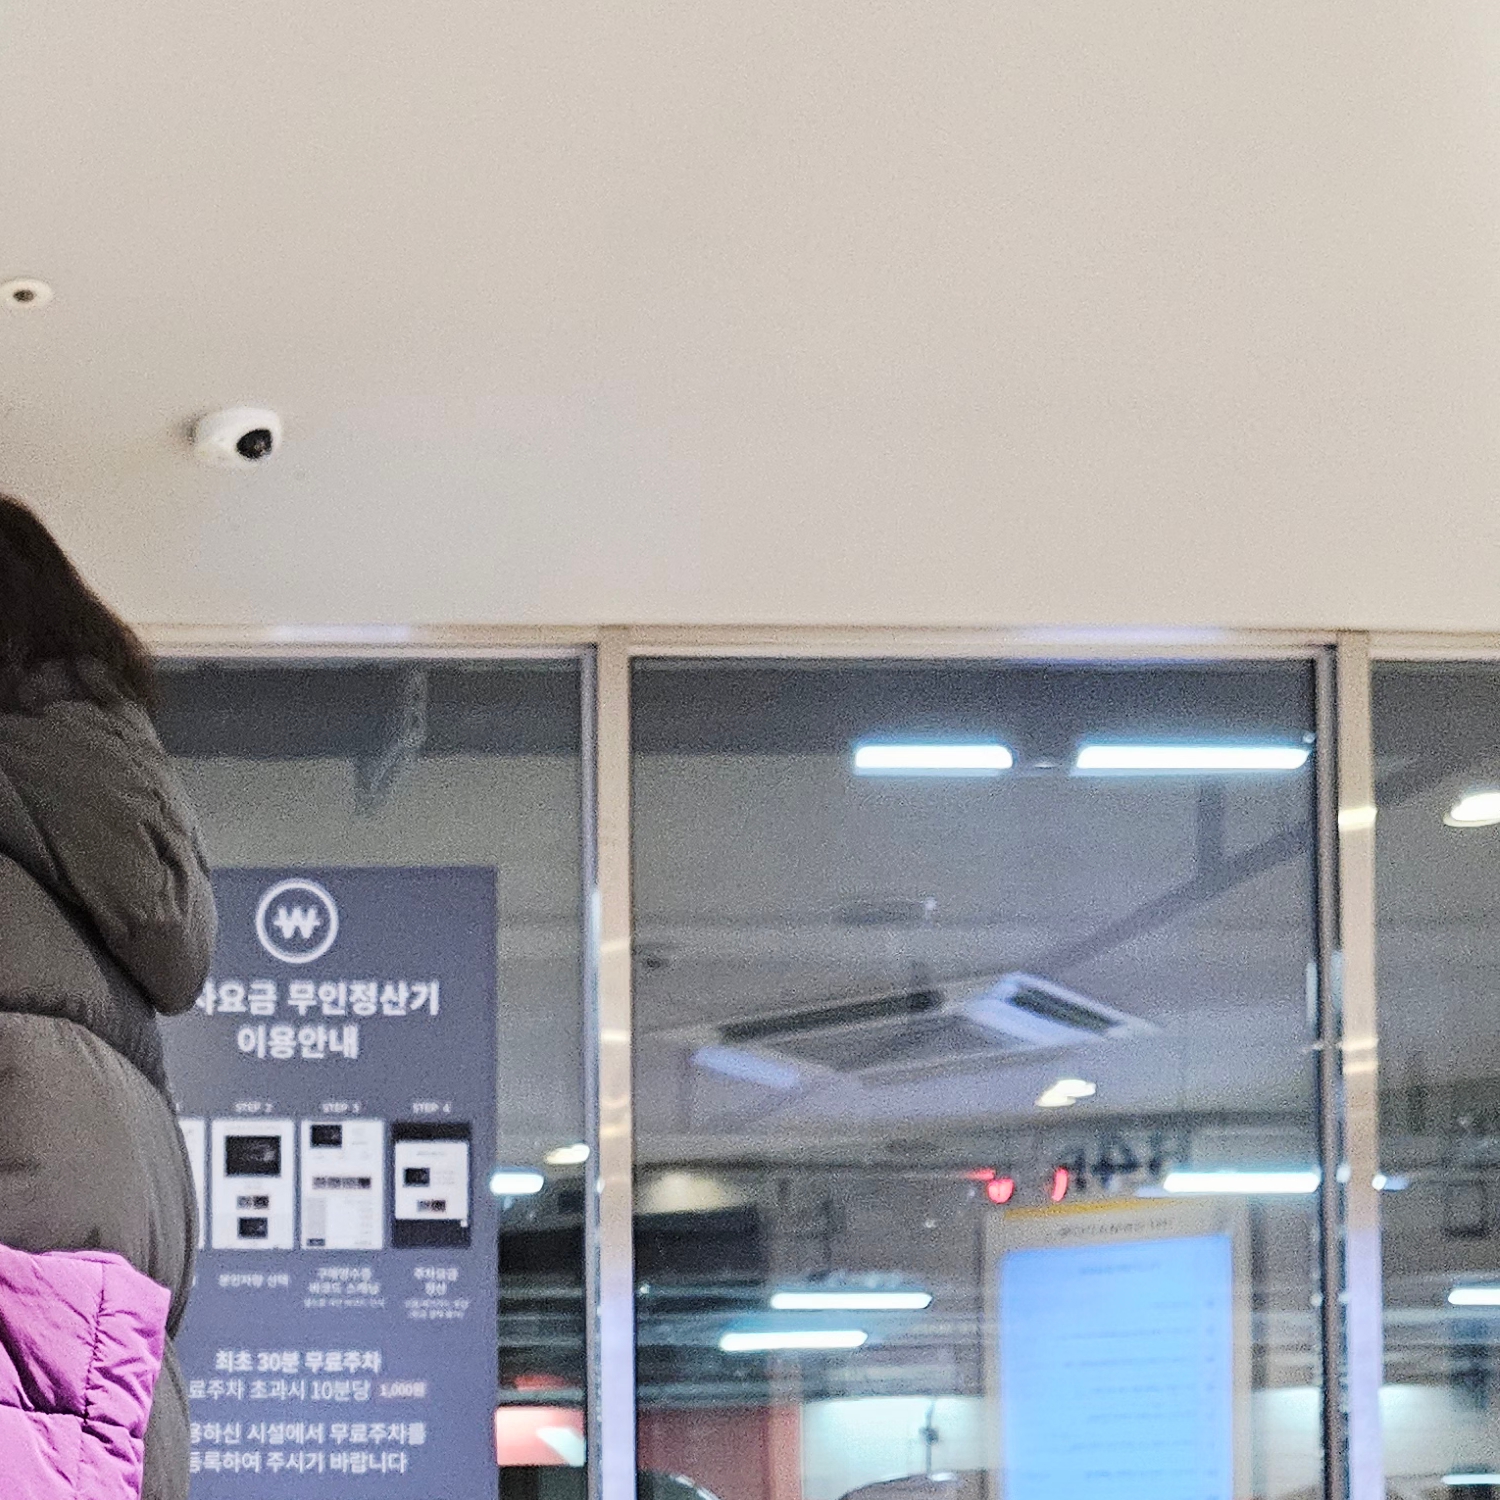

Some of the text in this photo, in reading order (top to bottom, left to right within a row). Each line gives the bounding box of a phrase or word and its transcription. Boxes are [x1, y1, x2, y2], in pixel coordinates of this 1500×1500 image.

[288, 979, 440, 1016] 무인정산기
[237, 1023, 359, 1059] 이용안내
[215, 1351, 382, 1373] 최초 30분 무료주차
[250, 1379, 305, 1400] 초과시
[311, 1379, 371, 1401] 10분당
[247, 1422, 324, 1444] 시설에서
[330, 1422, 426, 1445] 무료주차를
[267, 1451, 324, 1473] 주시기
[330, 1451, 408, 1473] 바랍니다
